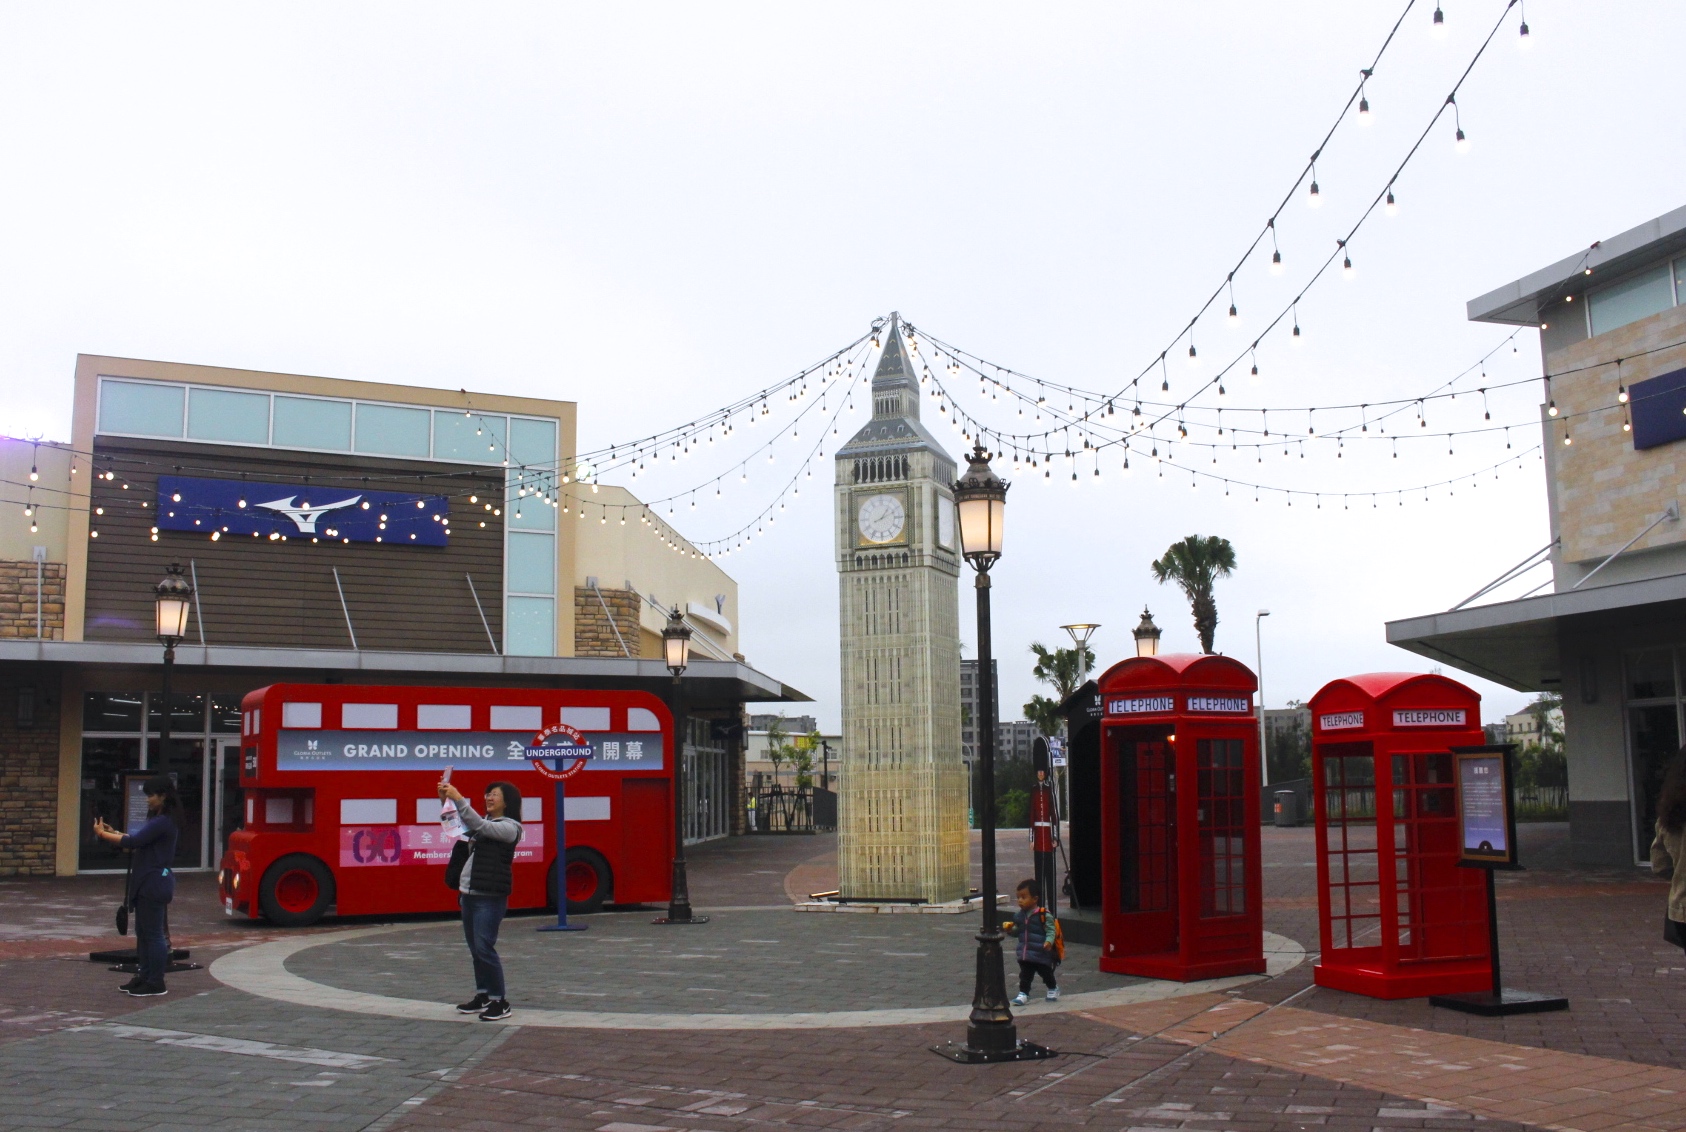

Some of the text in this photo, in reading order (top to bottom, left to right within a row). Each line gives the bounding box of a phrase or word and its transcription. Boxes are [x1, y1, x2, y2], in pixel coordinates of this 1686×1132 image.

[1110, 697, 1174, 713] TELEPHONE
[1323, 713, 1363, 727] TELEPHONE
[1398, 711, 1461, 723] TELEPHONE
[343, 744, 495, 758] GRAND OPENING
[526, 748, 592, 757] UNDERGROUND
